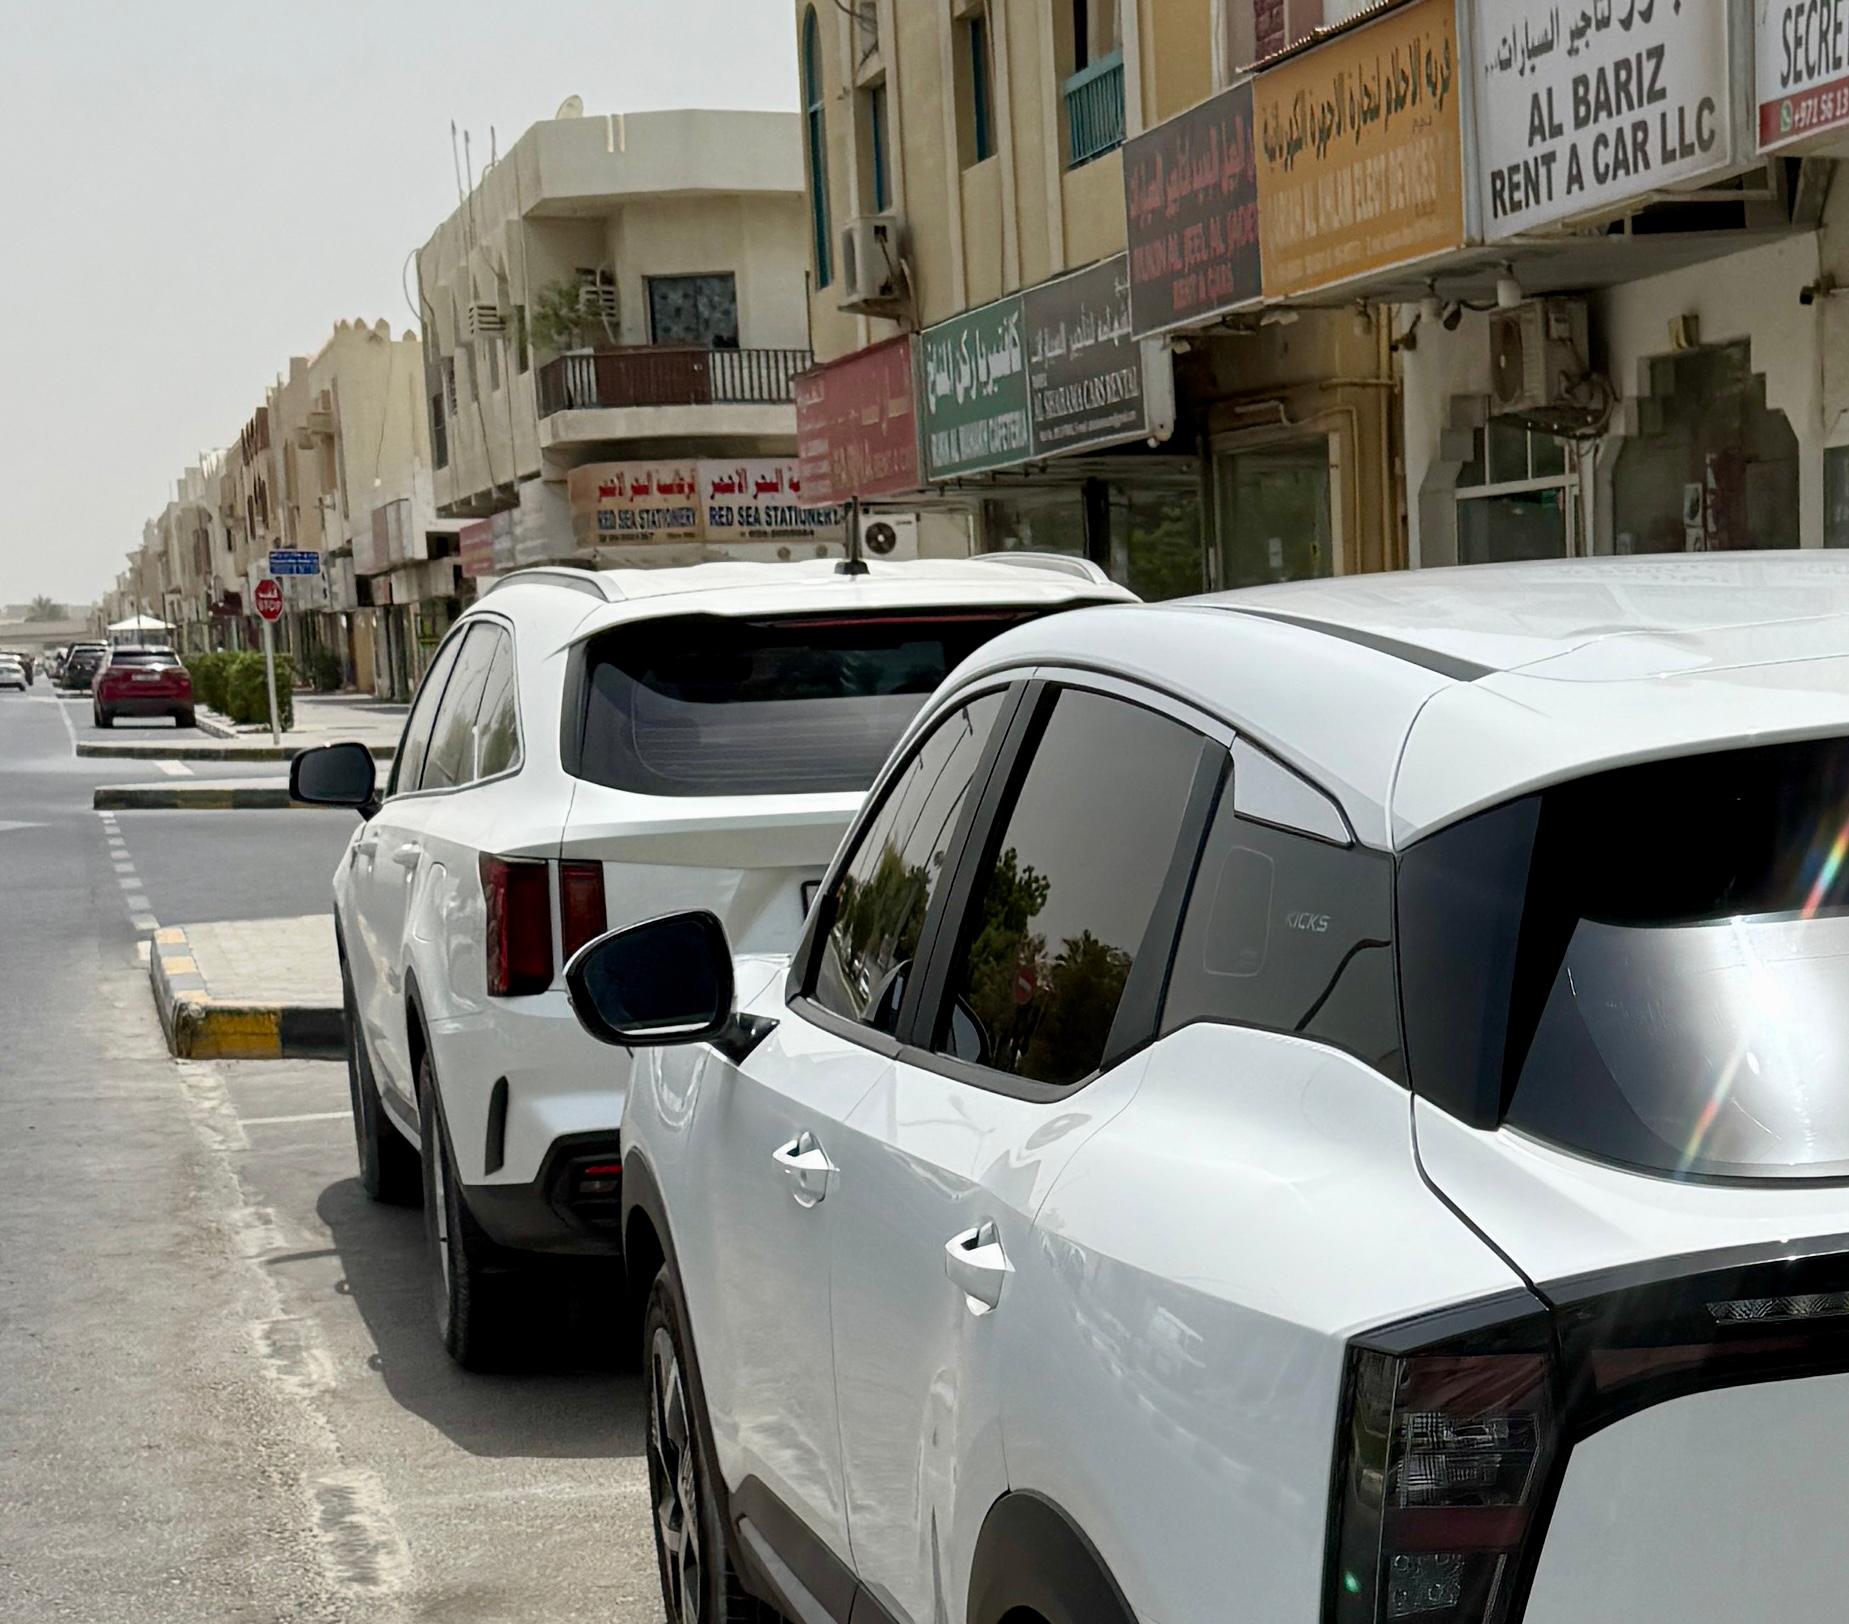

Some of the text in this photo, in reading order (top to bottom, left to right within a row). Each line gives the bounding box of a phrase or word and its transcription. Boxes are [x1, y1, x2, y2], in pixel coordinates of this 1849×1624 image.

[1528, 43, 1667, 147] AL BARIZ
[1491, 150, 1557, 219] RENT
[1566, 142, 1585, 195] A
[1592, 119, 1651, 185] CAR
[1660, 96, 1716, 165] LLC
[618, 508, 637, 530] SEA
[709, 506, 734, 527] RED
[737, 506, 761, 527] SEA
